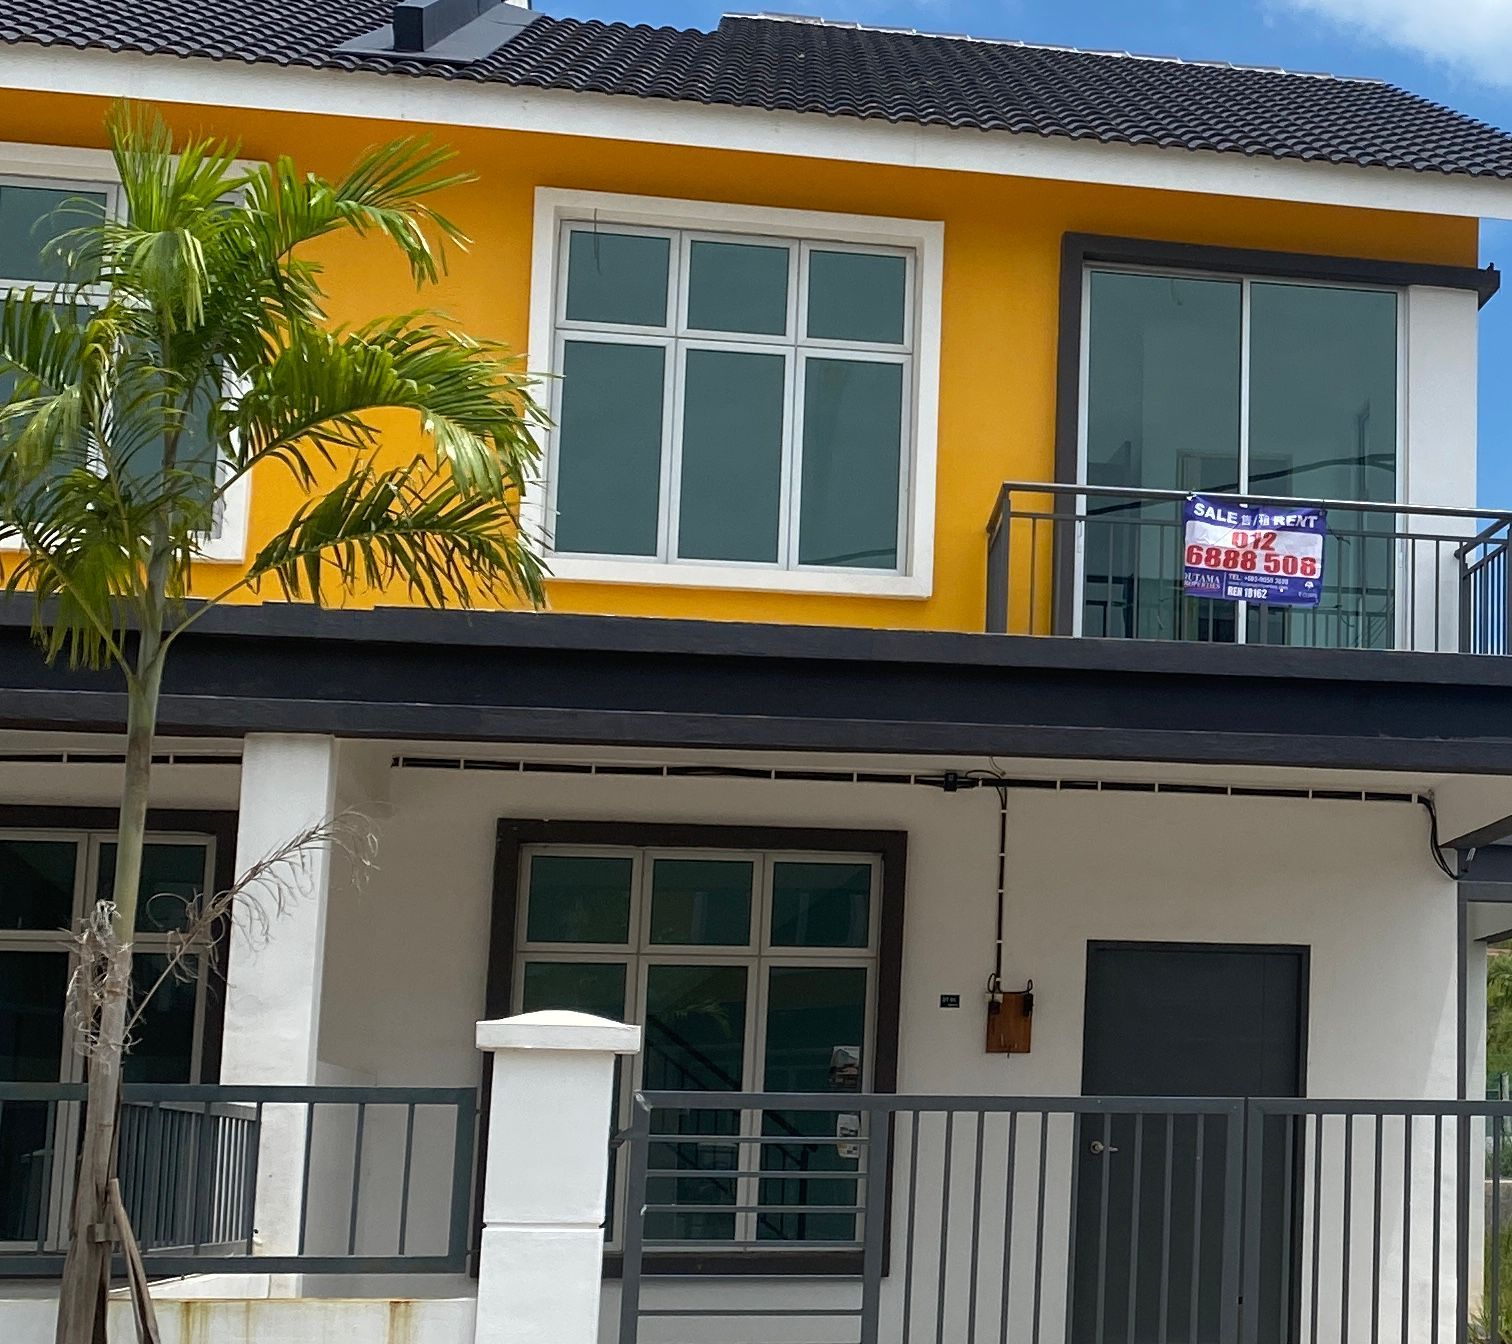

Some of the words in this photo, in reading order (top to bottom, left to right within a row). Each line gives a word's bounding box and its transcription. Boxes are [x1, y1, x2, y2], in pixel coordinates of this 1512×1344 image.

[1193, 503, 1238, 525] SALE
[1273, 515, 1318, 529] RENT
[1231, 531, 1277, 551] 012
[1186, 544, 1257, 571] 6888
[1264, 553, 1317, 577] 508
